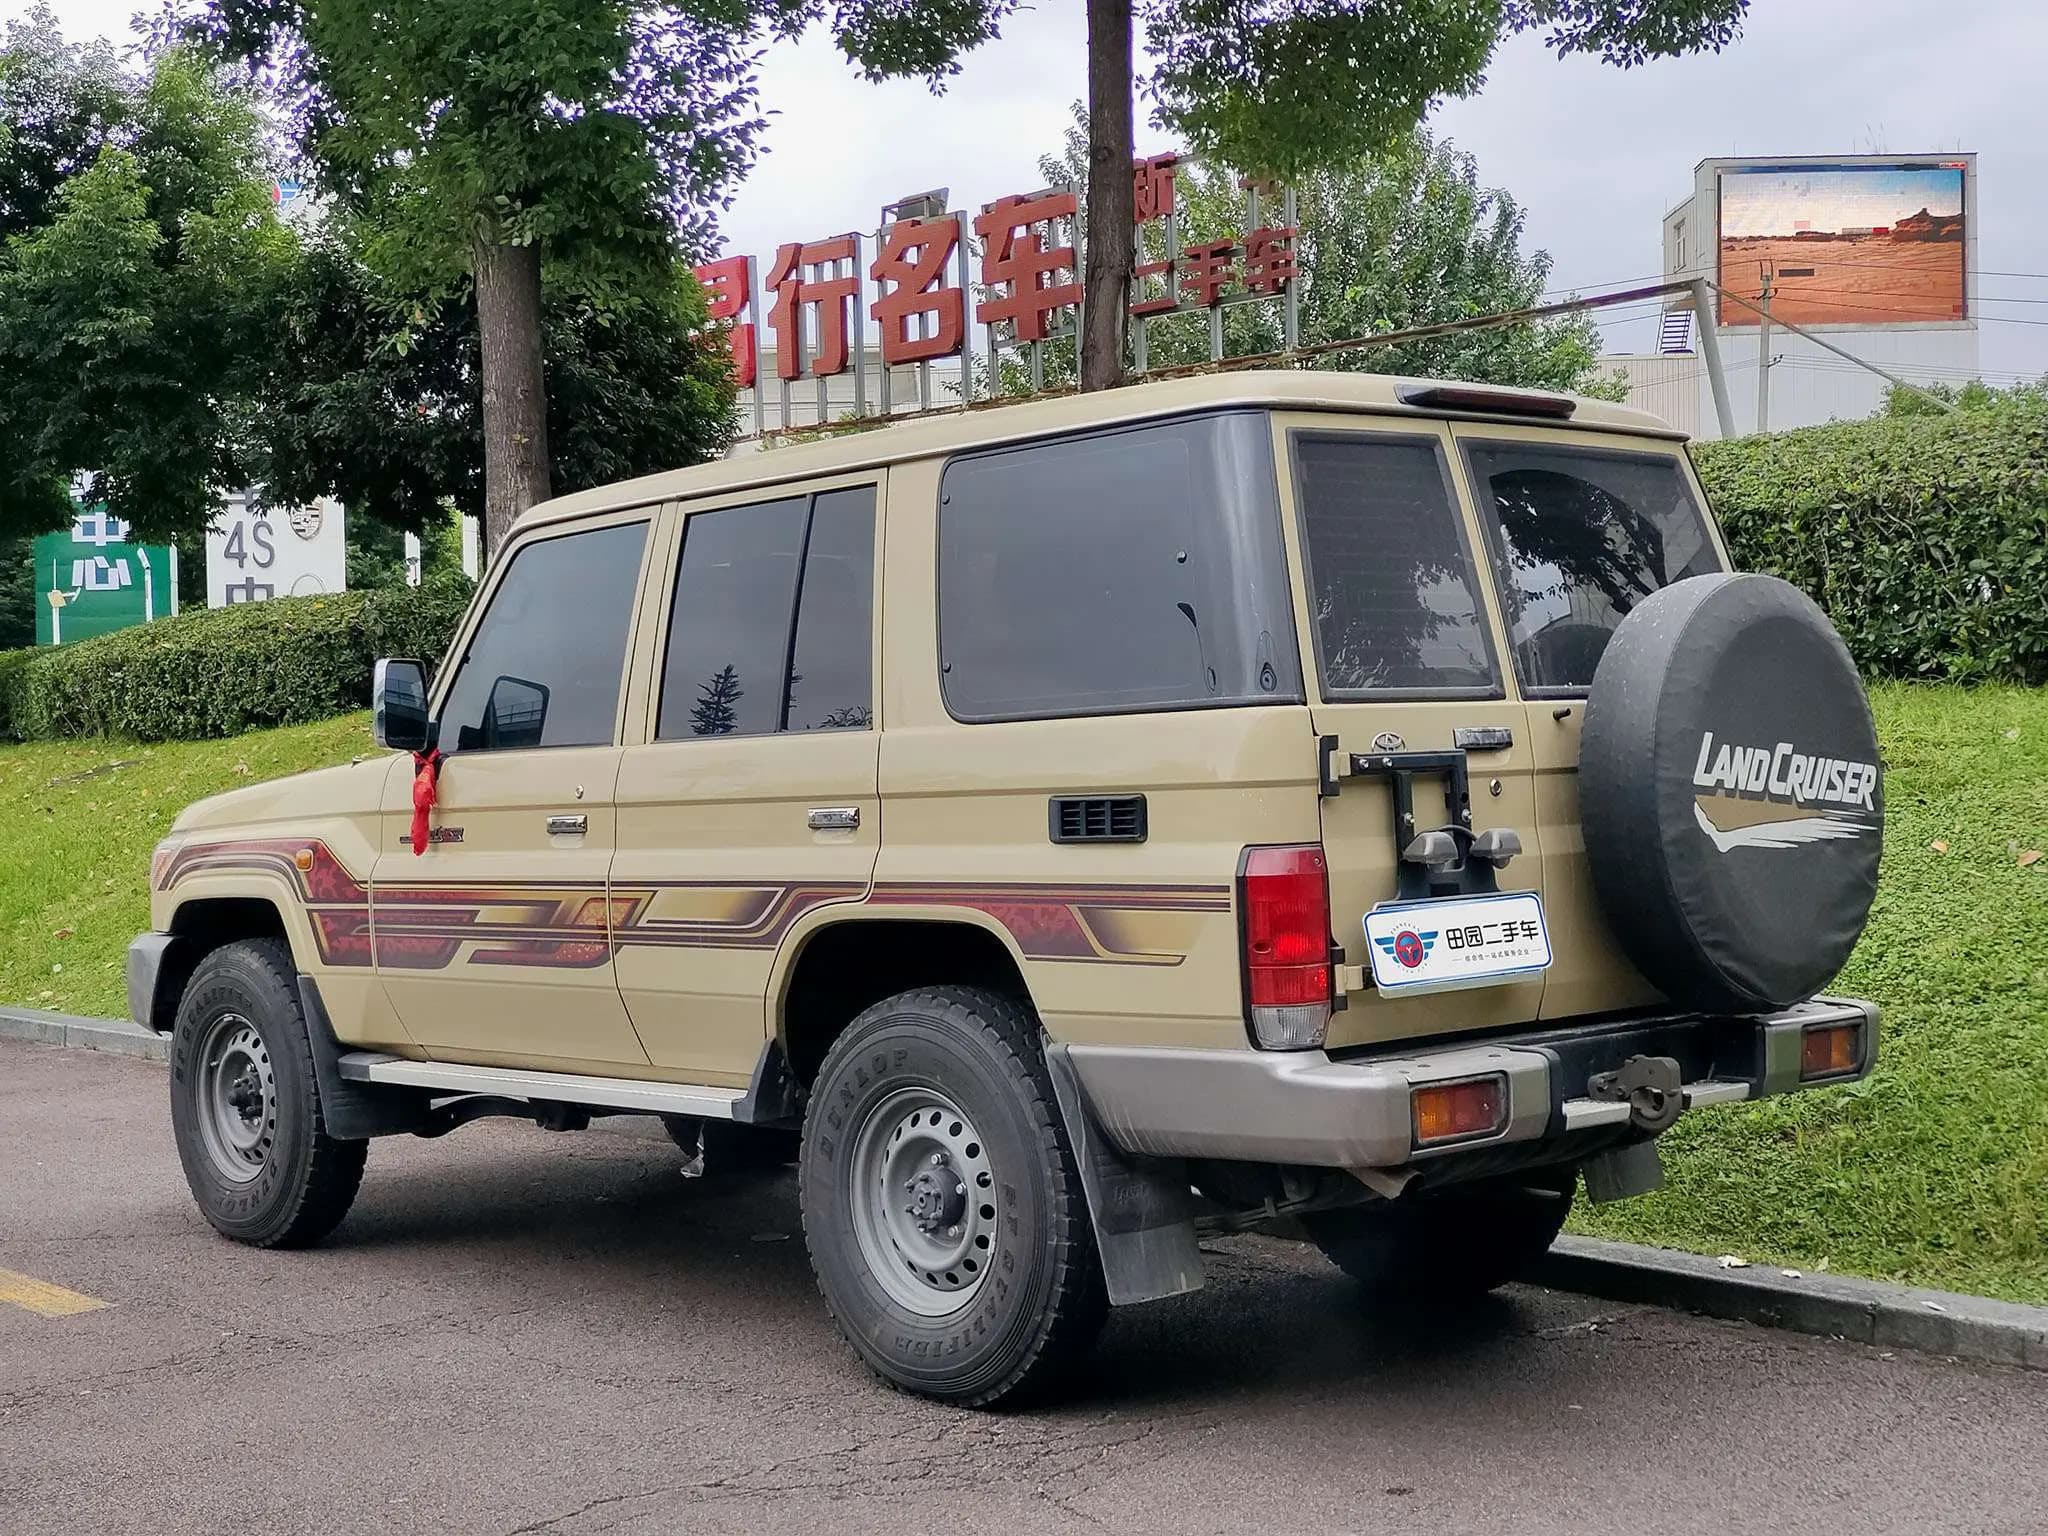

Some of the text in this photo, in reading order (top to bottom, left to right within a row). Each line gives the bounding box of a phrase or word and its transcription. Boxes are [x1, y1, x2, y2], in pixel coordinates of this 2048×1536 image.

[1128, 228, 1300, 314] 二手车
[1446, 920, 1539, 950] 田园二手车
[820, 1048, 908, 1162] DUNLOP
